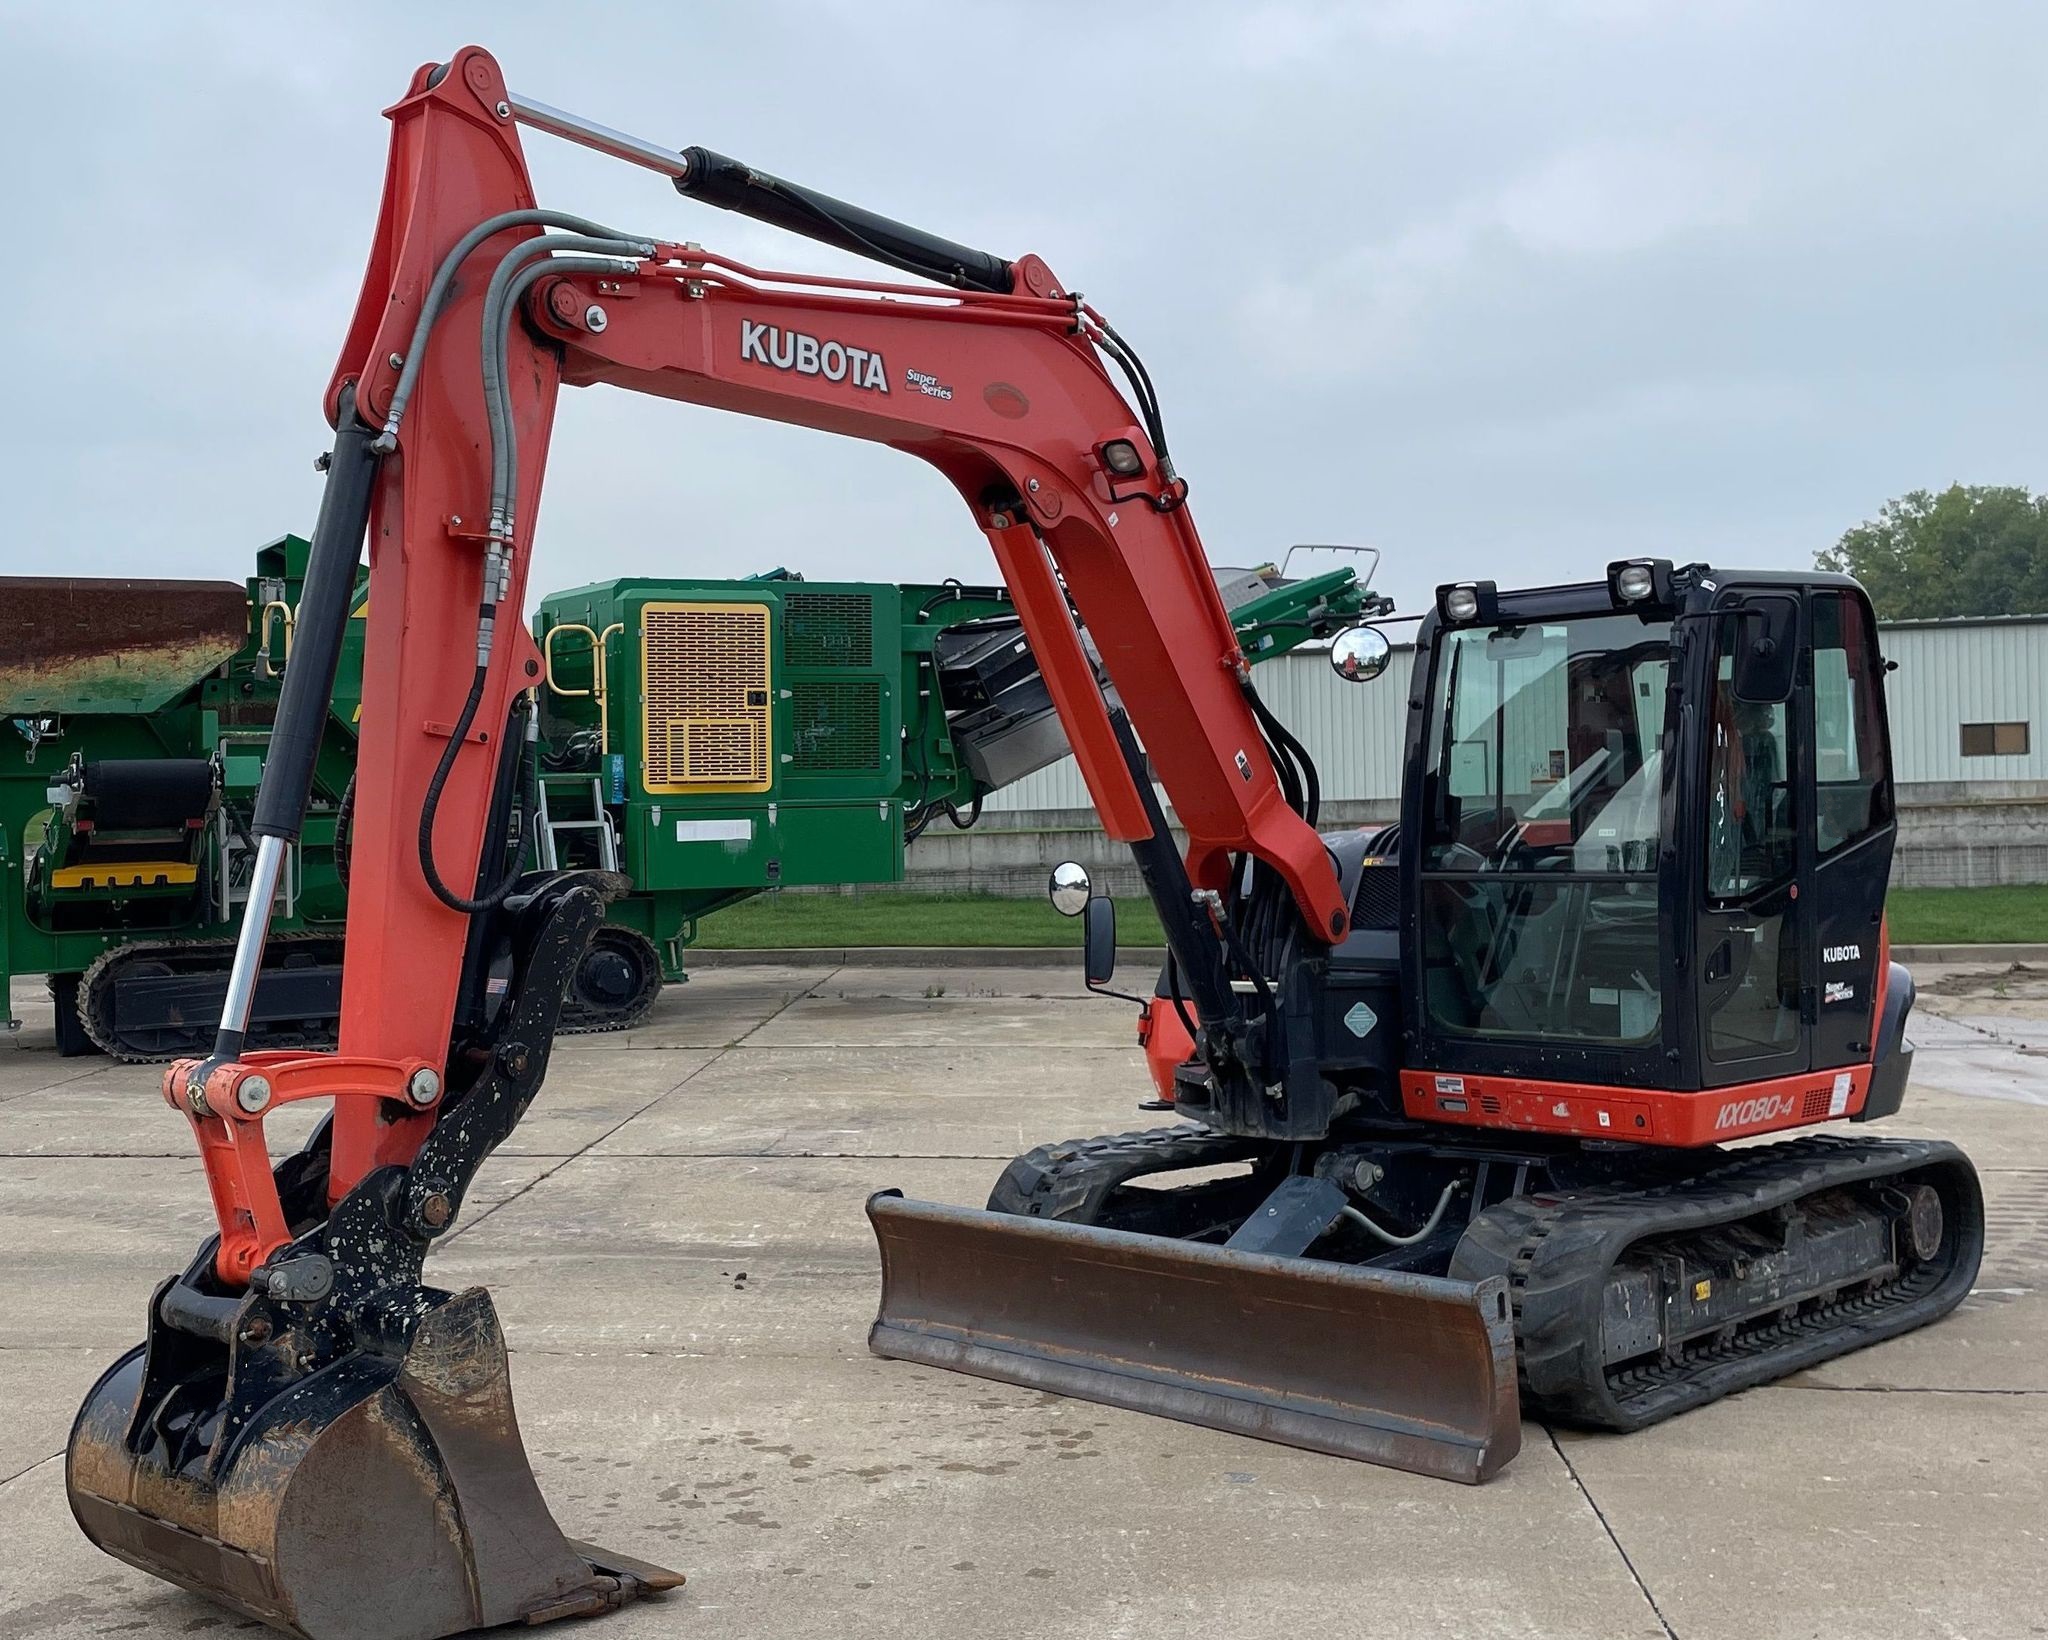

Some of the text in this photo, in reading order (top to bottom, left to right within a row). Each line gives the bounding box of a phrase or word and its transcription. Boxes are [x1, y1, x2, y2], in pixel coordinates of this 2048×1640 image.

[741, 319, 888, 392] KUBOTA
[906, 368, 938, 386] Super
[920, 383, 953, 400] Series
[1823, 945, 1860, 962] KUBOTA
[1714, 1095, 1795, 1130] KX080-4
